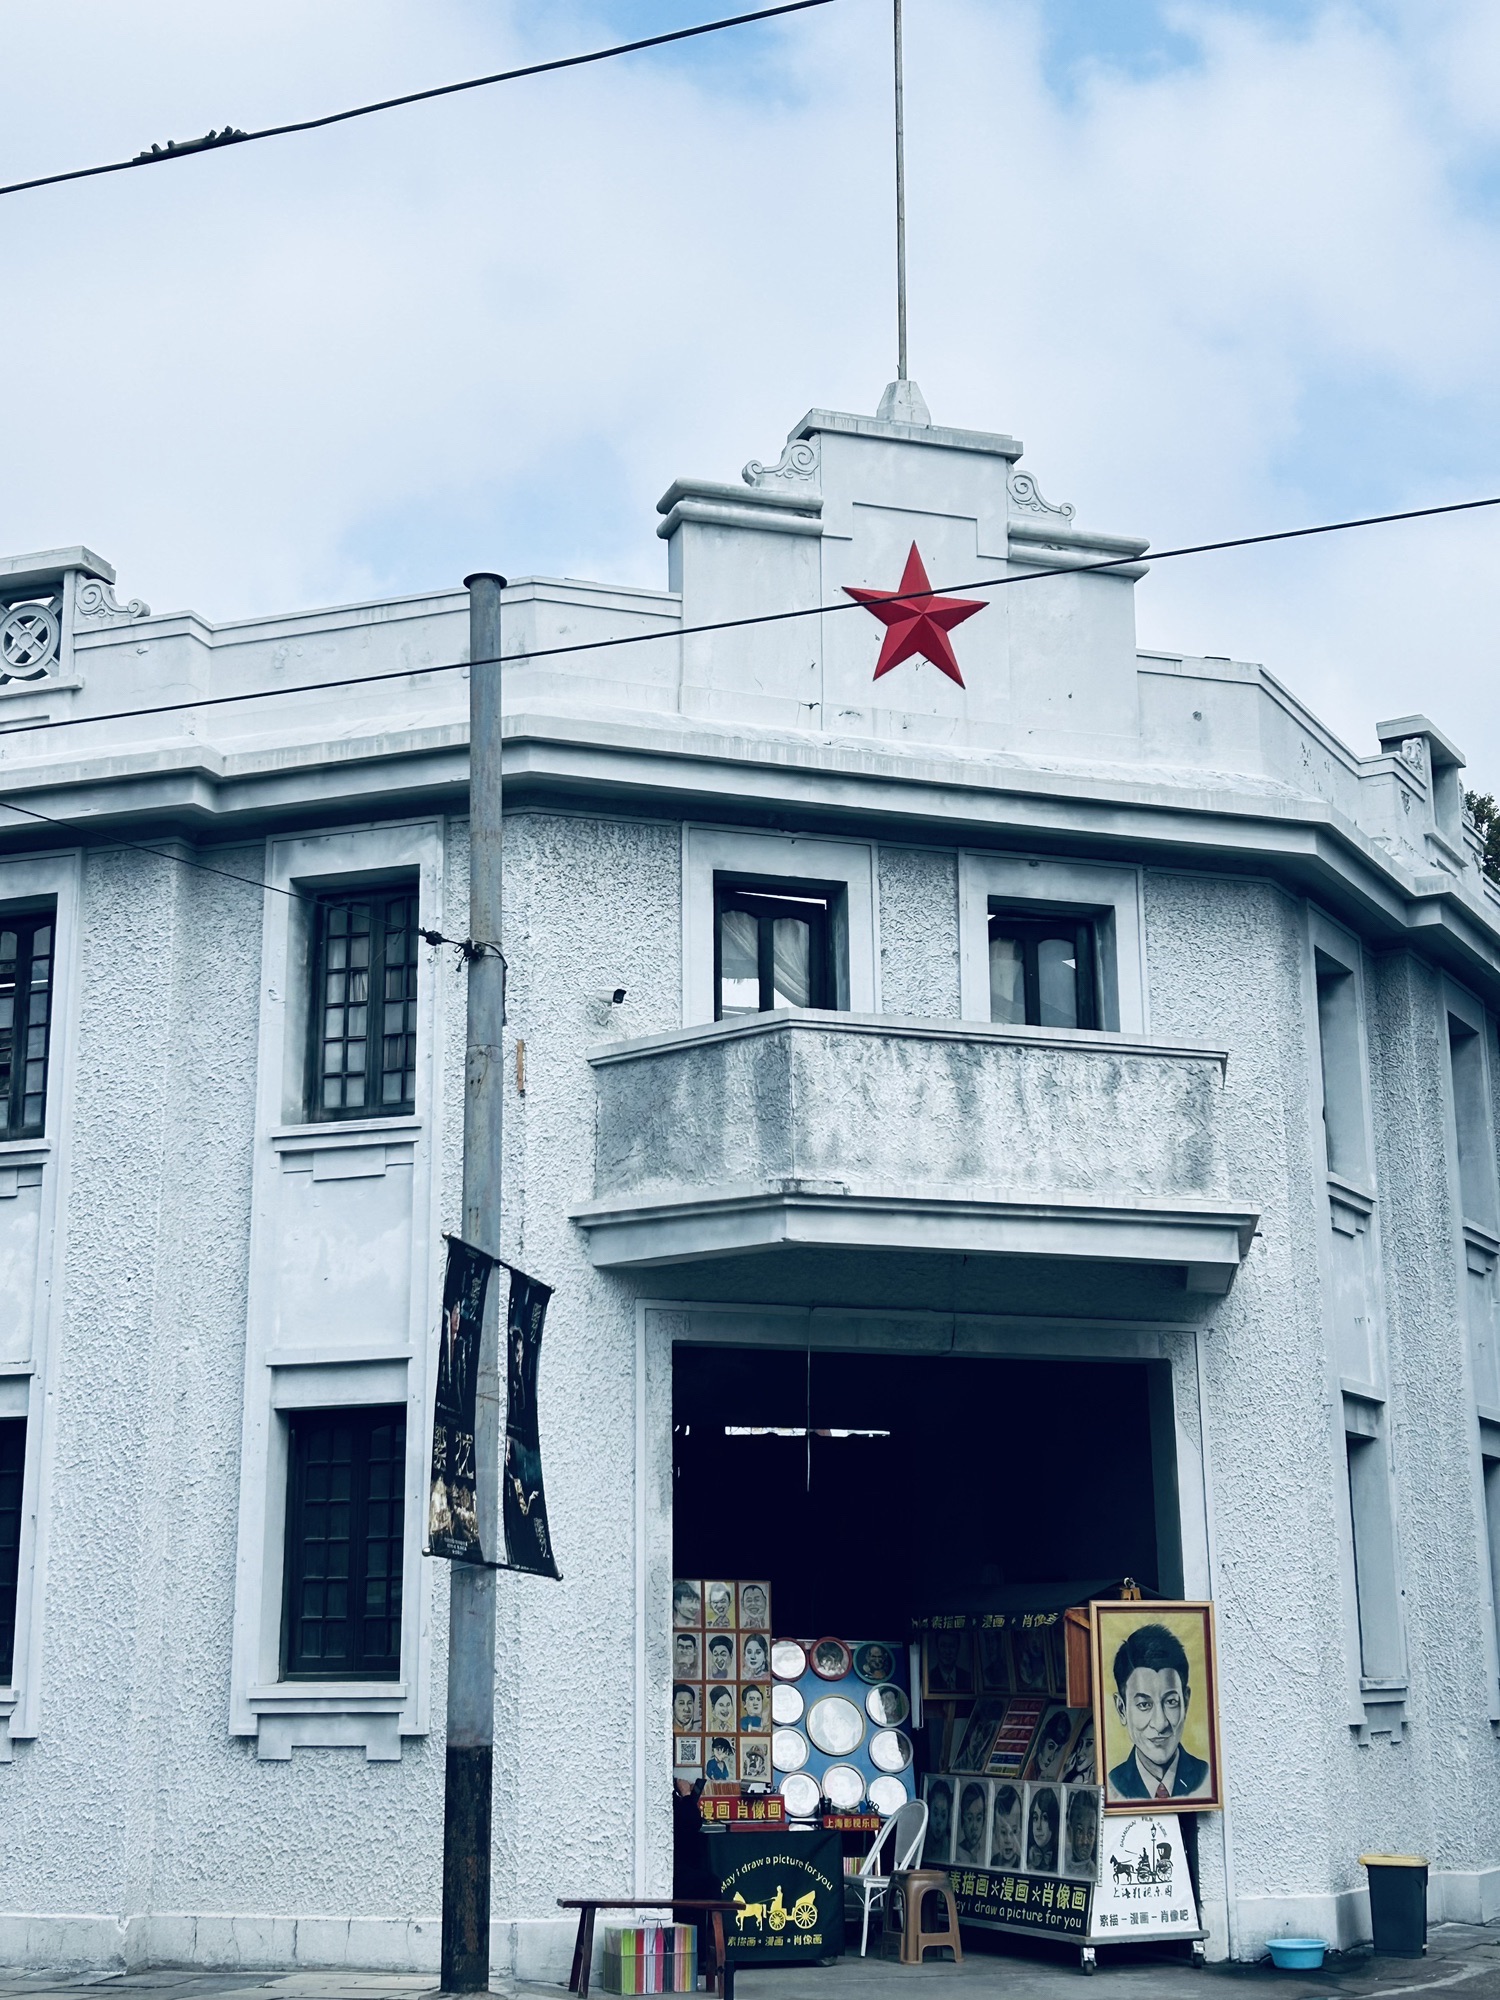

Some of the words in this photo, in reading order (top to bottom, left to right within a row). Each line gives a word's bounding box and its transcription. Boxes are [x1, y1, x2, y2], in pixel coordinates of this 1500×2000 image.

[700, 1800, 730, 1820] 漫画
[736, 1800, 782, 1820] 肖像画
[826, 1818, 879, 1829] 上海影视乐园
[741, 1858, 764, 1874] draw
[765, 1856, 771, 1865] a
[772, 1853, 804, 1868] picture
[804, 1861, 817, 1875] for
[815, 1872, 834, 1891] you
[999, 1876, 1030, 1904] 漫画
[1042, 1881, 1087, 1912] 肖像画
[974, 1900, 998, 1916] draw
[999, 1907, 1005, 1917] a
[1006, 1907, 1044, 1922] picture
[1045, 1909, 1062, 1924] for
[1063, 1916, 1082, 1930] you
